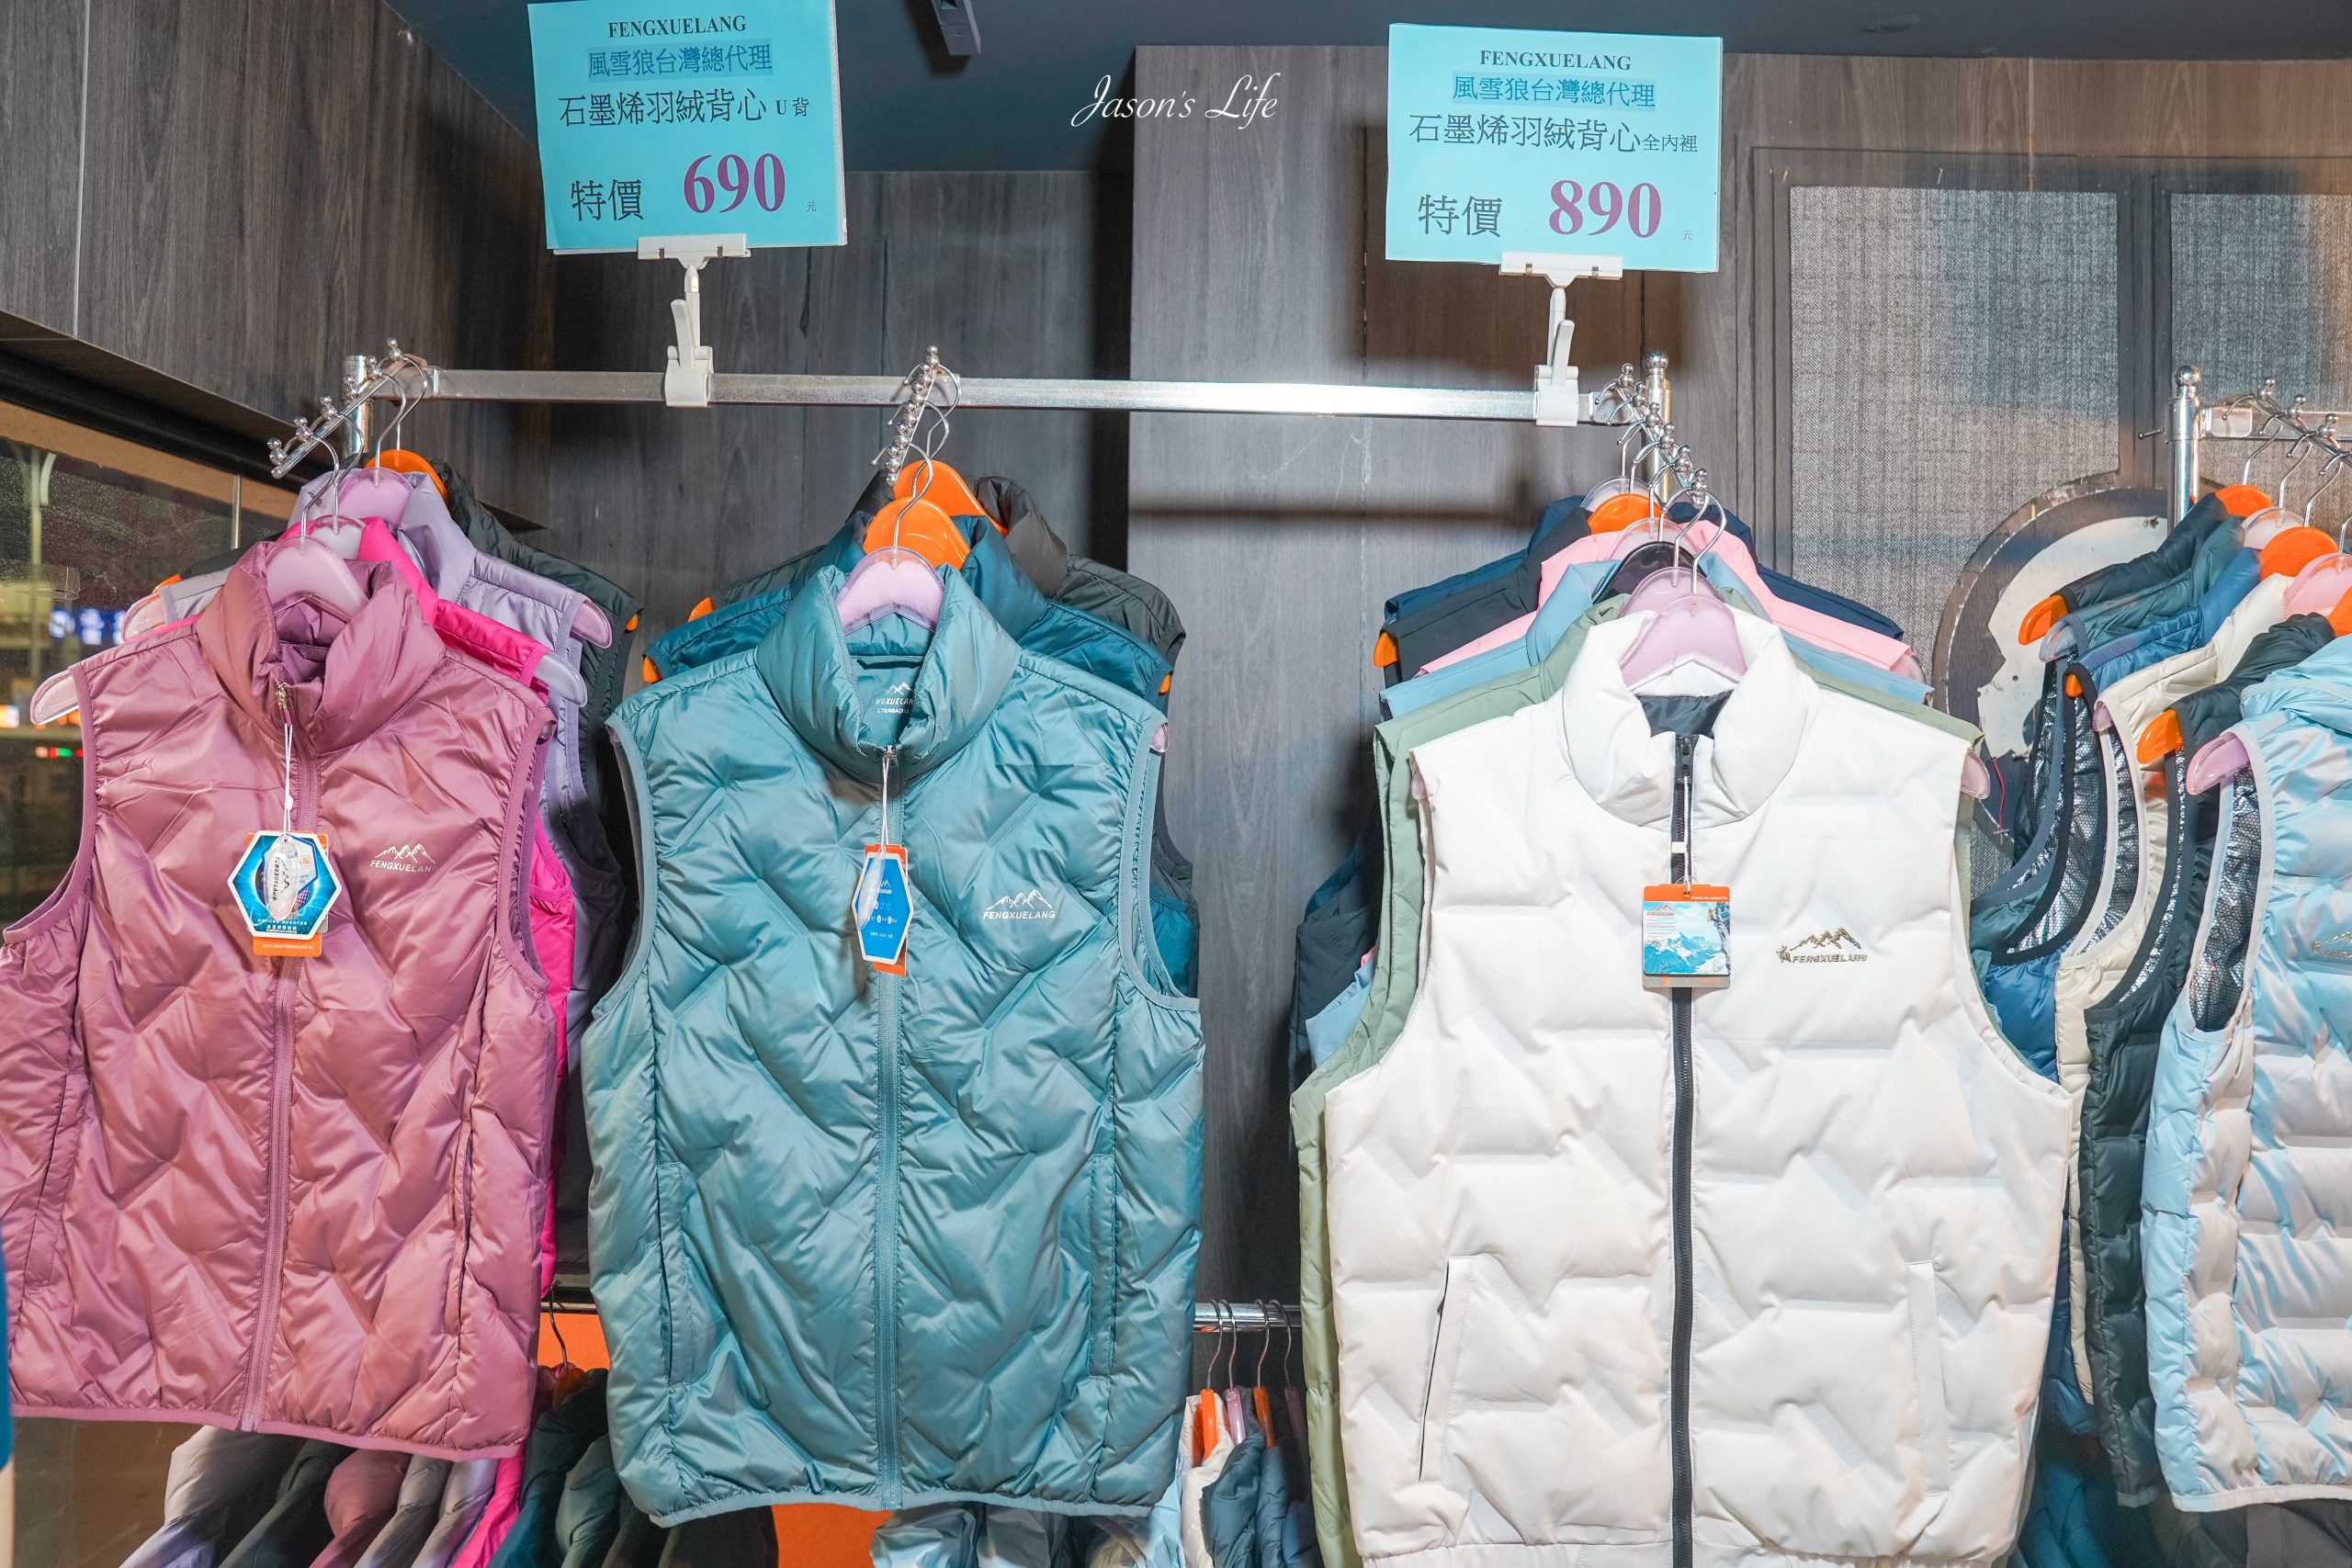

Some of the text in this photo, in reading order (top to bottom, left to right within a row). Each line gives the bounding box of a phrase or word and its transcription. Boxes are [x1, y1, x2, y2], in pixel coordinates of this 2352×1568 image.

[607, 15, 747, 38] FENGXUELANG
[587, 44, 773, 79] 風雪狼台灣總代理
[1479, 50, 1632, 71] FENGXUELANG
[559, 88, 766, 127] 石墨烯羽絨背心
[1452, 74, 1657, 107] 風雪狼台灣總代理
[571, 179, 644, 221] 特價
[684, 152, 786, 214] 690
[1418, 194, 1503, 238] 特價
[1548, 180, 1662, 238] 890
[982, 910, 1057, 919] FENGXUELANG
